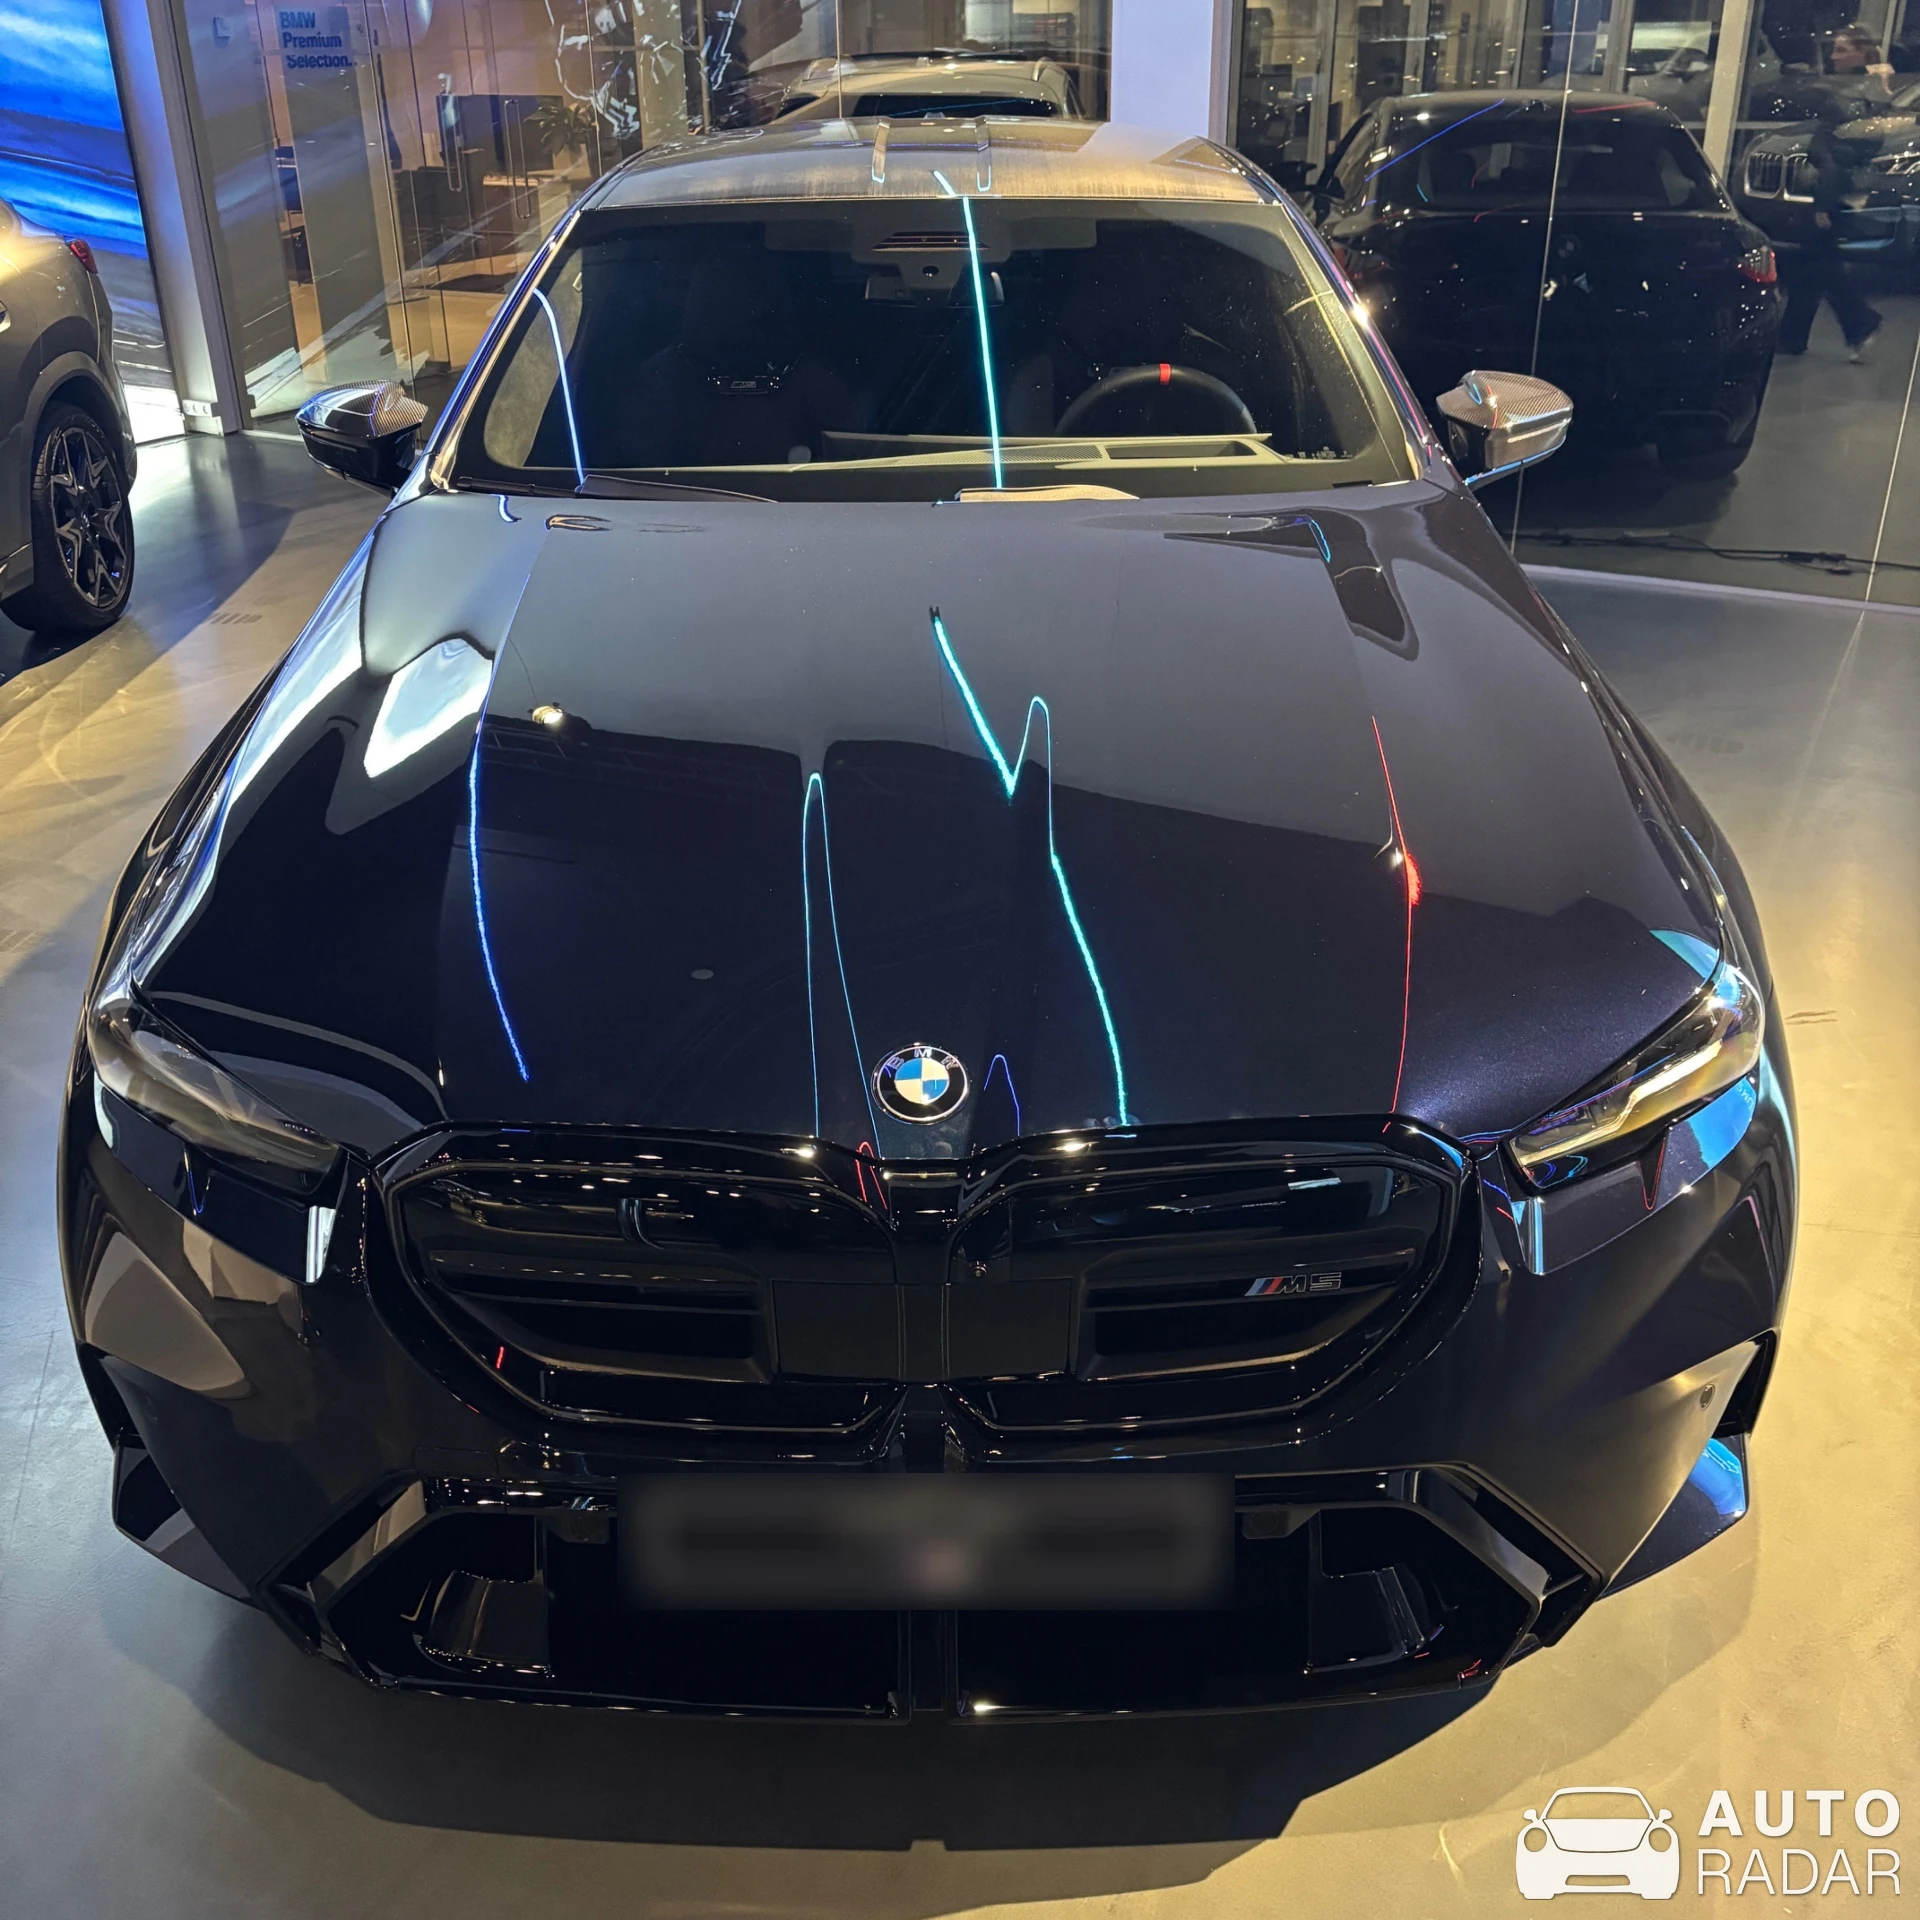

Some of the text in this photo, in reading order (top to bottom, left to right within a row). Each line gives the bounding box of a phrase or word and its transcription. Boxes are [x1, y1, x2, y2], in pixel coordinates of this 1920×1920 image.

[280, 11, 316, 29] BMW
[282, 31, 343, 48] Premium
[886, 1047, 960, 1070] BMW
